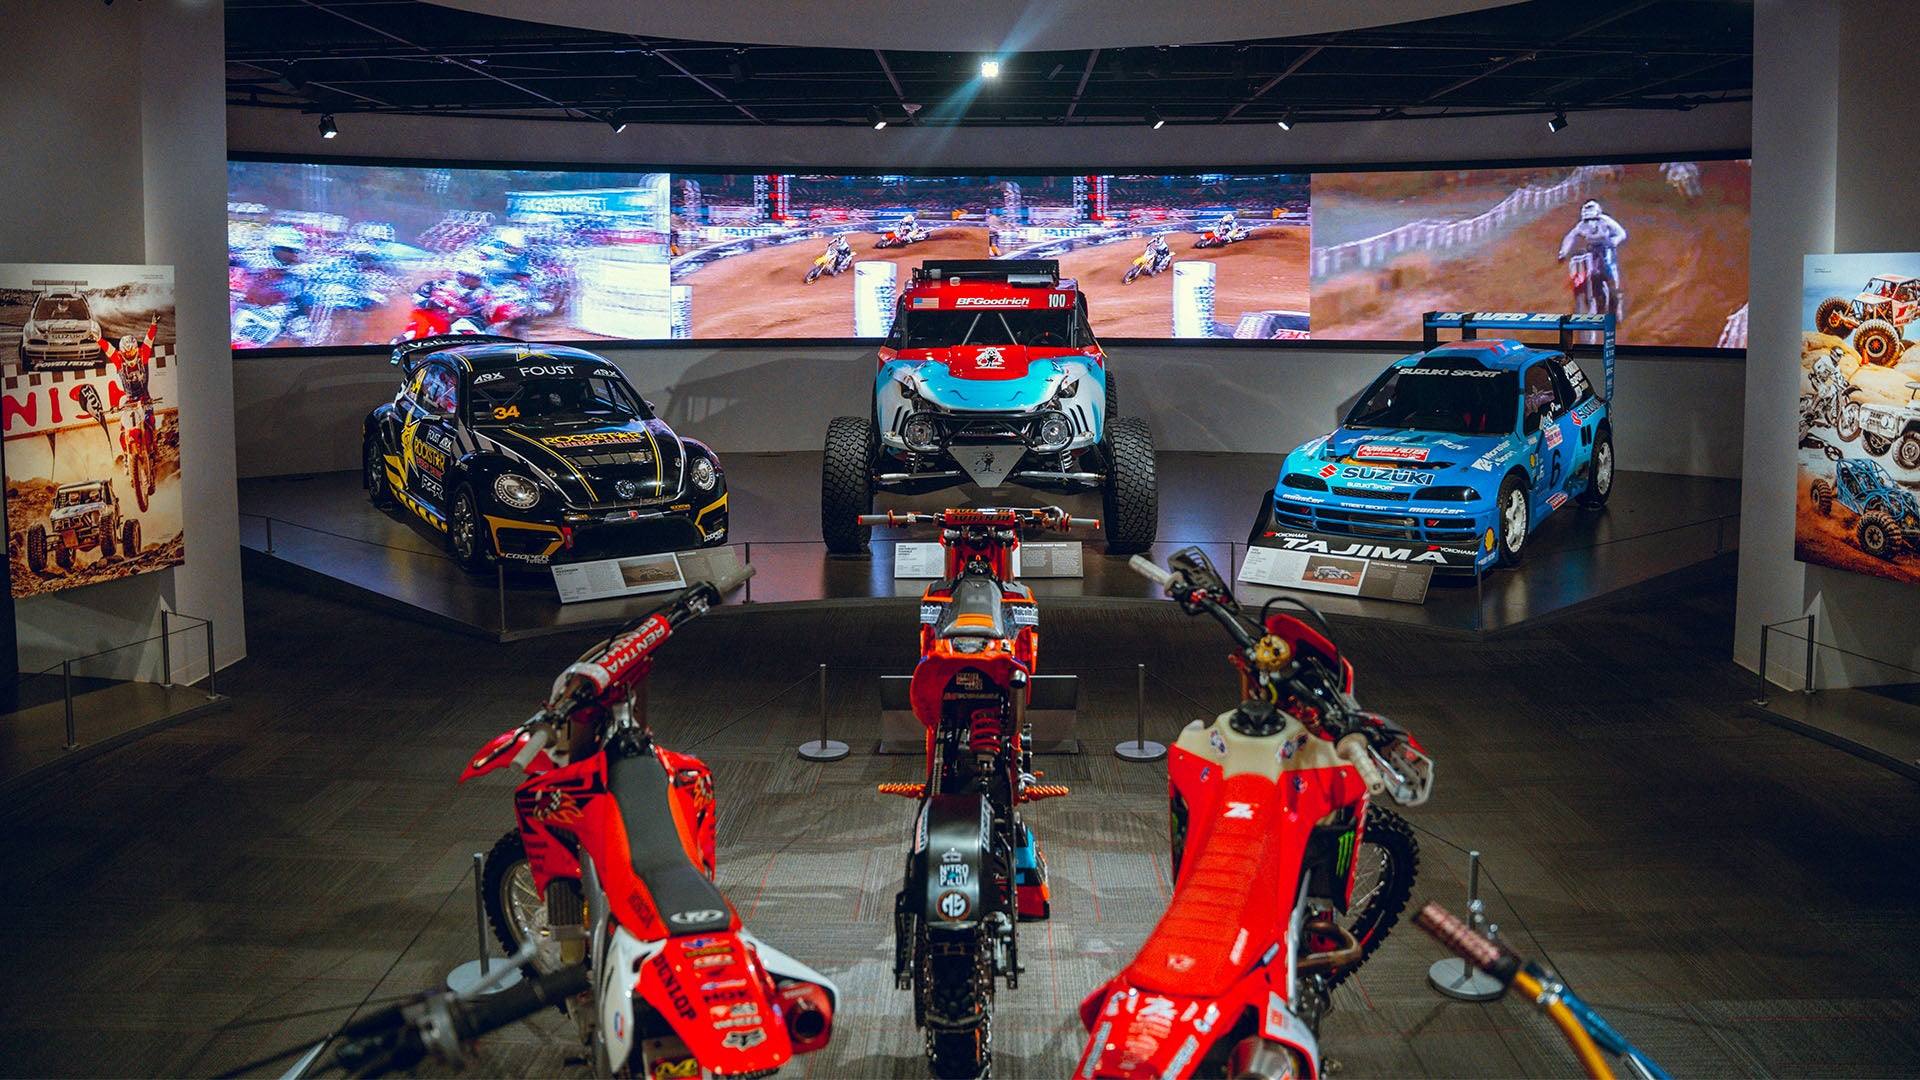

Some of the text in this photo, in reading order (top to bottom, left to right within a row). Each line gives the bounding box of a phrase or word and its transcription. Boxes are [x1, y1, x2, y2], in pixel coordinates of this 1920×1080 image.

[955, 297, 1029, 305] BFGoodrich
[1048, 294, 1065, 307] 100
[519, 365, 575, 377] FOUST
[1450, 369, 1501, 378] SPORT
[493, 405, 520, 420] 34
[1549, 449, 1561, 488] 6
[1342, 467, 1435, 486] SUZUKI
[1408, 506, 1464, 515] monster
[505, 553, 549, 561] COOPER
[1283, 538, 1448, 564] TAJIMA
[1440, 548, 1478, 556] YOKOHAMA
[597, 618, 658, 663] RENTHA
[606, 625, 665, 673] RENTHA
[940, 864, 969, 875] NITRO
[940, 874, 969, 887] PILOT
[652, 954, 697, 1020] DUNLOP
